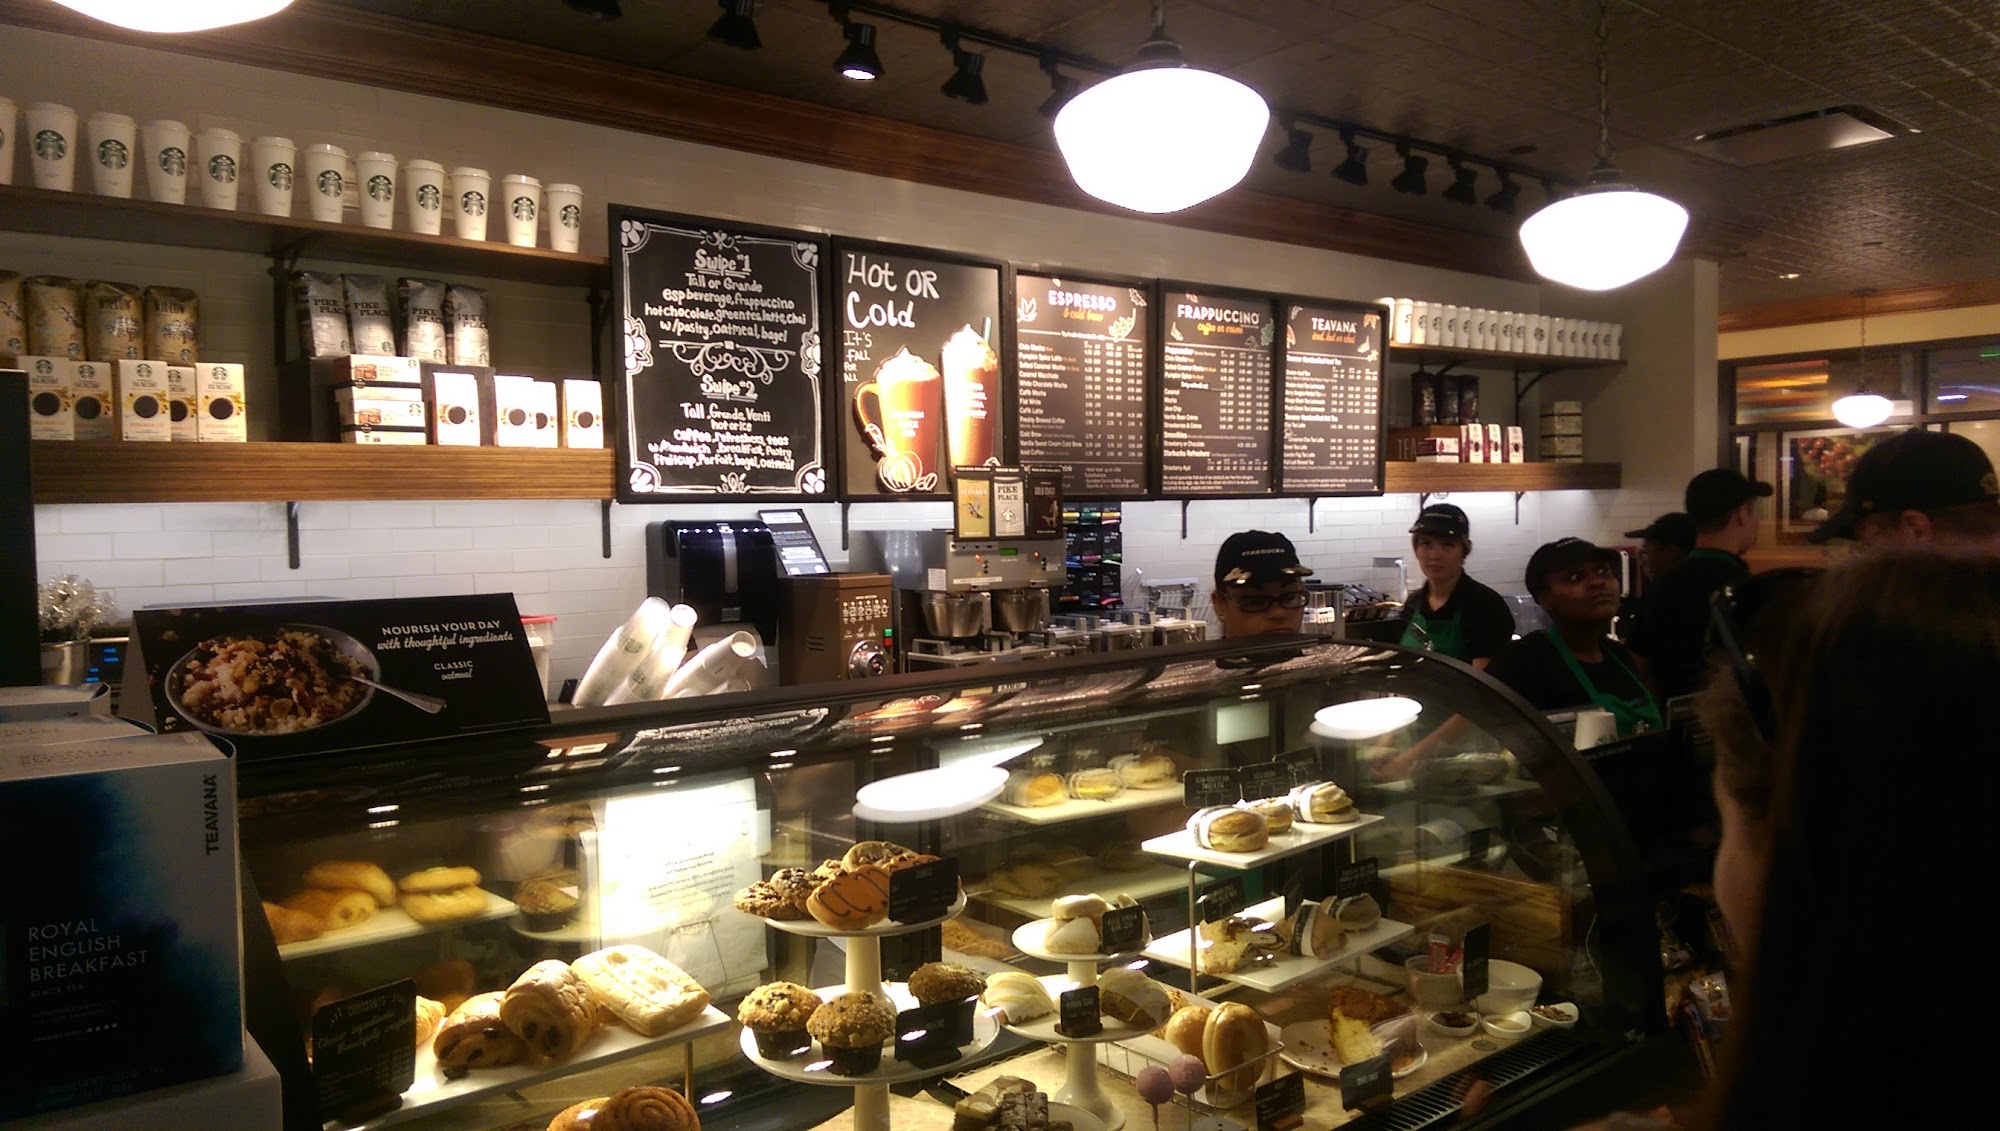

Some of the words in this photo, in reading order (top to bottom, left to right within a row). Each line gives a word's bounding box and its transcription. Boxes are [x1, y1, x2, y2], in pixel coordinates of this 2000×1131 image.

[694, 248, 736, 275] Swipe
[685, 273, 706, 288] Tall
[708, 279, 721, 290] or
[724, 277, 763, 293] Grande
[848, 254, 896, 291] Hot
[906, 270, 940, 298] OR
[354, 302, 380, 310] PIKE
[662, 288, 686, 305] esp
[1048, 290, 1116, 312] ESPRESSO
[320, 306, 346, 315] PLAC
[412, 308, 438, 316] PIKE
[416, 315, 443, 324] PLAC
[847, 291, 916, 328] Cold
[1178, 304, 1260, 324] FRAPPUCCINO
[762, 326, 788, 344] bagel
[1312, 318, 1356, 334] TEAVANA
[700, 374, 740, 400] Swipe
[746, 408, 771, 422] Venti
[382, 624, 439, 636] NOURISH
[441, 622, 476, 632] YOUR
[478, 620, 500, 629] DAY
[377, 637, 401, 650] with
[404, 632, 457, 652] thoughtful
[459, 630, 514, 648] ingredients
[434, 660, 474, 670] CLASSIC
[442, 668, 473, 680] oatmeal
[204, 774, 219, 856] TEAVANA
[28, 918, 98, 941] ROYAL
[29, 936, 120, 961] ENGLISH
[30, 950, 148, 982] BREAKFAST
